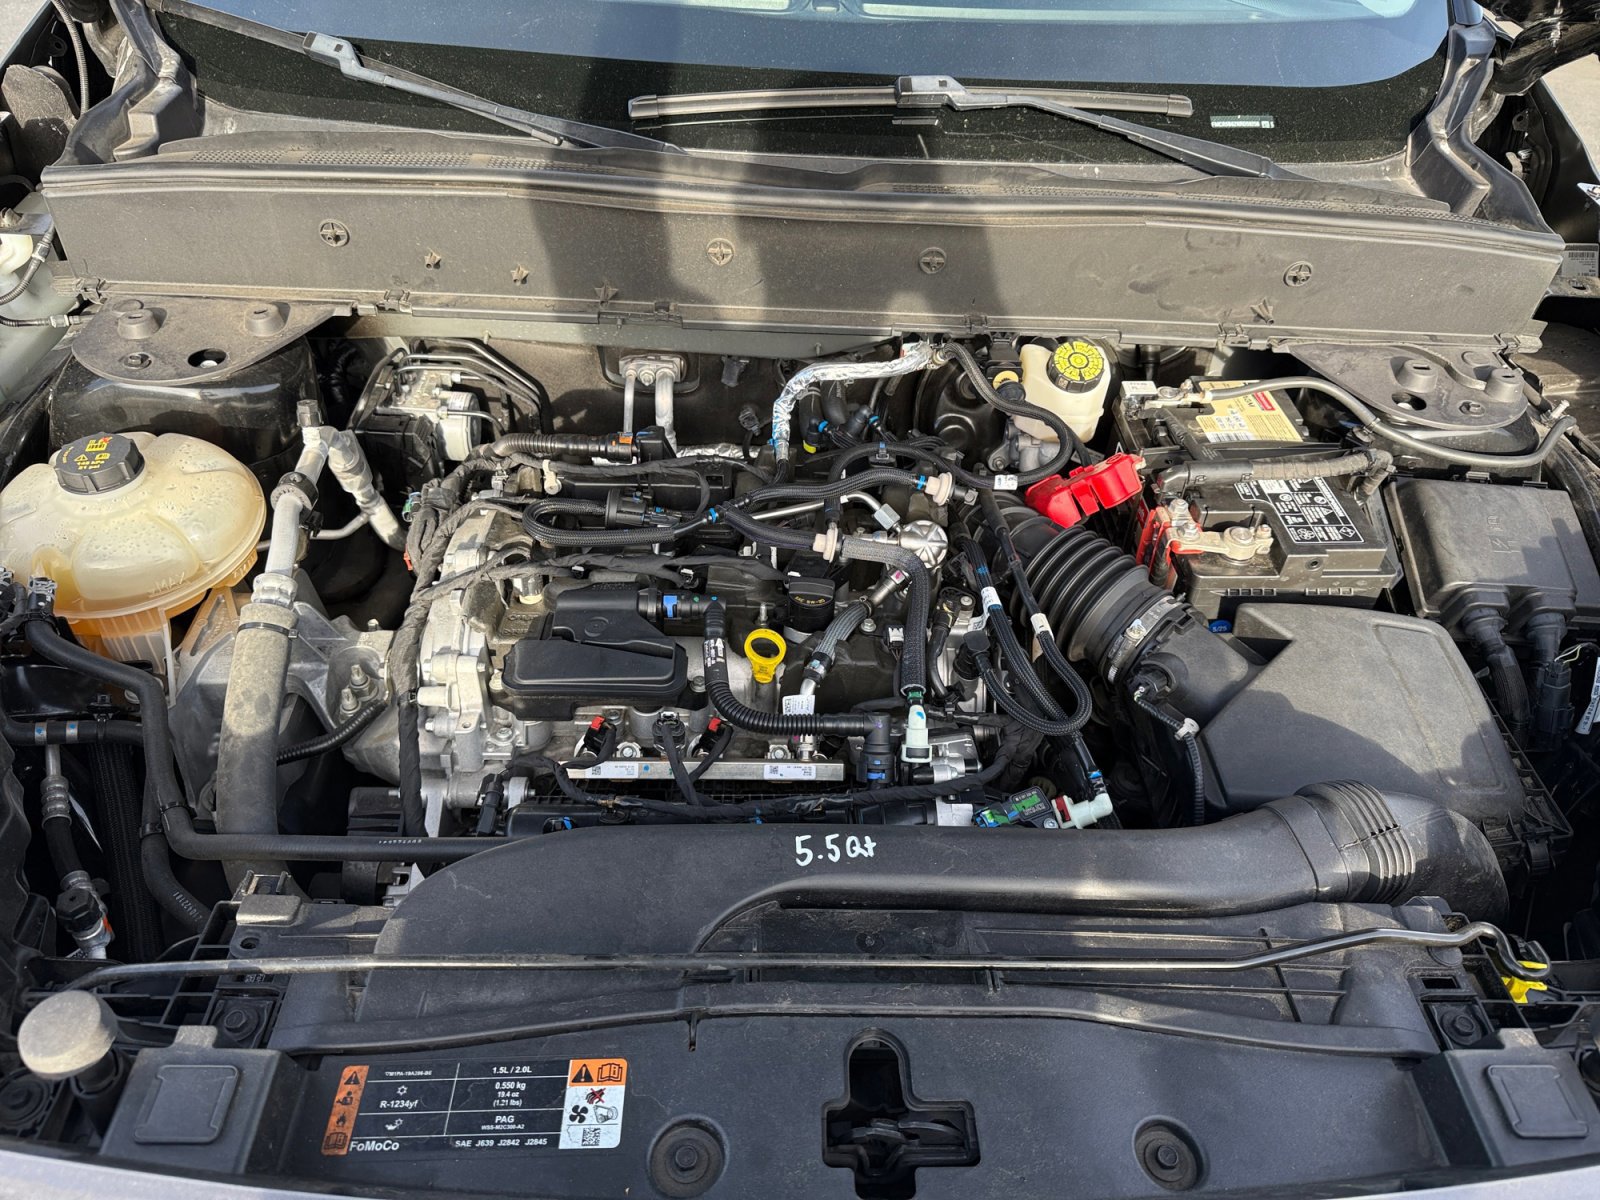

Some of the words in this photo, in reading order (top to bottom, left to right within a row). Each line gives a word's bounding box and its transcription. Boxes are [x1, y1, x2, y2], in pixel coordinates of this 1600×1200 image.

[492, 1066, 509, 1074] 1.5L
[515, 1065, 532, 1073] 2.0L
[494, 1081, 515, 1090] 0.550
[516, 1081, 527, 1091] kg
[379, 1100, 419, 1110] R-1234yf
[495, 1115, 515, 1124] PAG
[349, 1140, 400, 1152] FoMoCo
[455, 1140, 472, 1148] SAE
[497, 1139, 521, 1147] J2842
[524, 1138, 548, 1146] J2845
